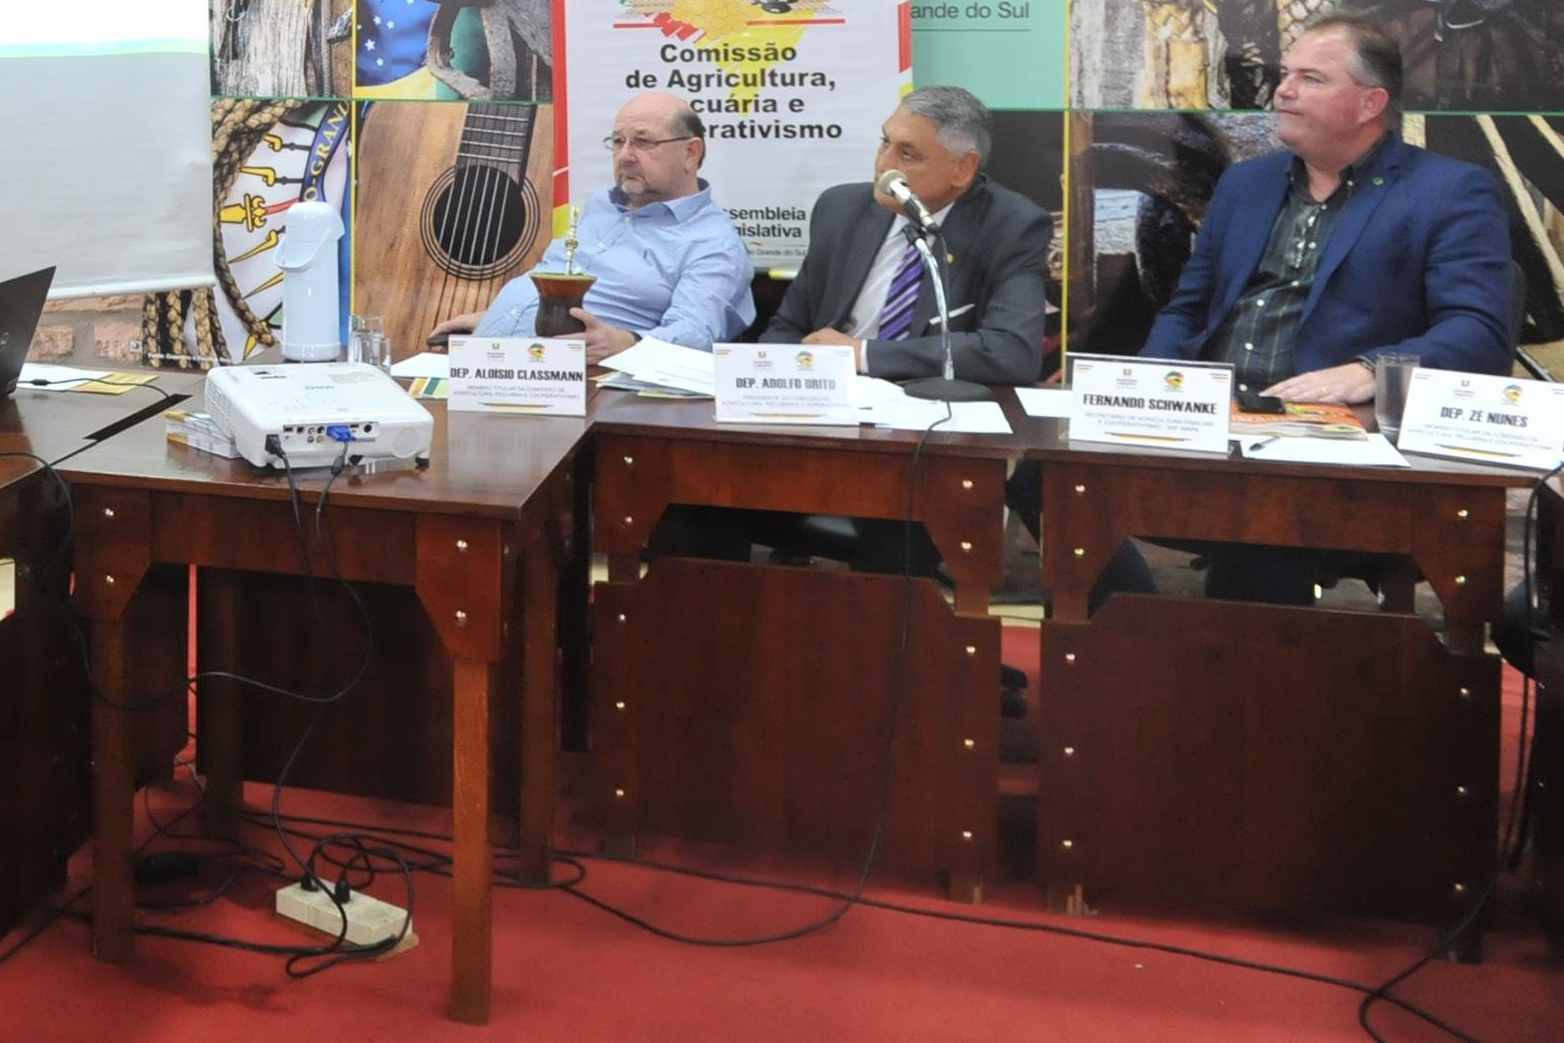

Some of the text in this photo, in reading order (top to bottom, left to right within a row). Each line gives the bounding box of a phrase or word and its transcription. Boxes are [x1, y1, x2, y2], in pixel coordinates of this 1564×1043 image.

[910, 1, 1030, 19] ande do Sul
[660, 42, 797, 62] Comissão
[625, 68, 835, 92] de Agricultura,
[690, 94, 805, 113] cuária e
[703, 119, 843, 139] rativismo
[726, 206, 806, 220] sembleia
[450, 367, 472, 379] DEP.
[517, 369, 584, 382] CLASSMANN
[736, 377, 836, 390] DEP. ADOLFO BRITO
[1083, 393, 1218, 415] FERNANDO SCHWANKE
[1440, 406, 1529, 428] DEP. ZÉ NUNES
